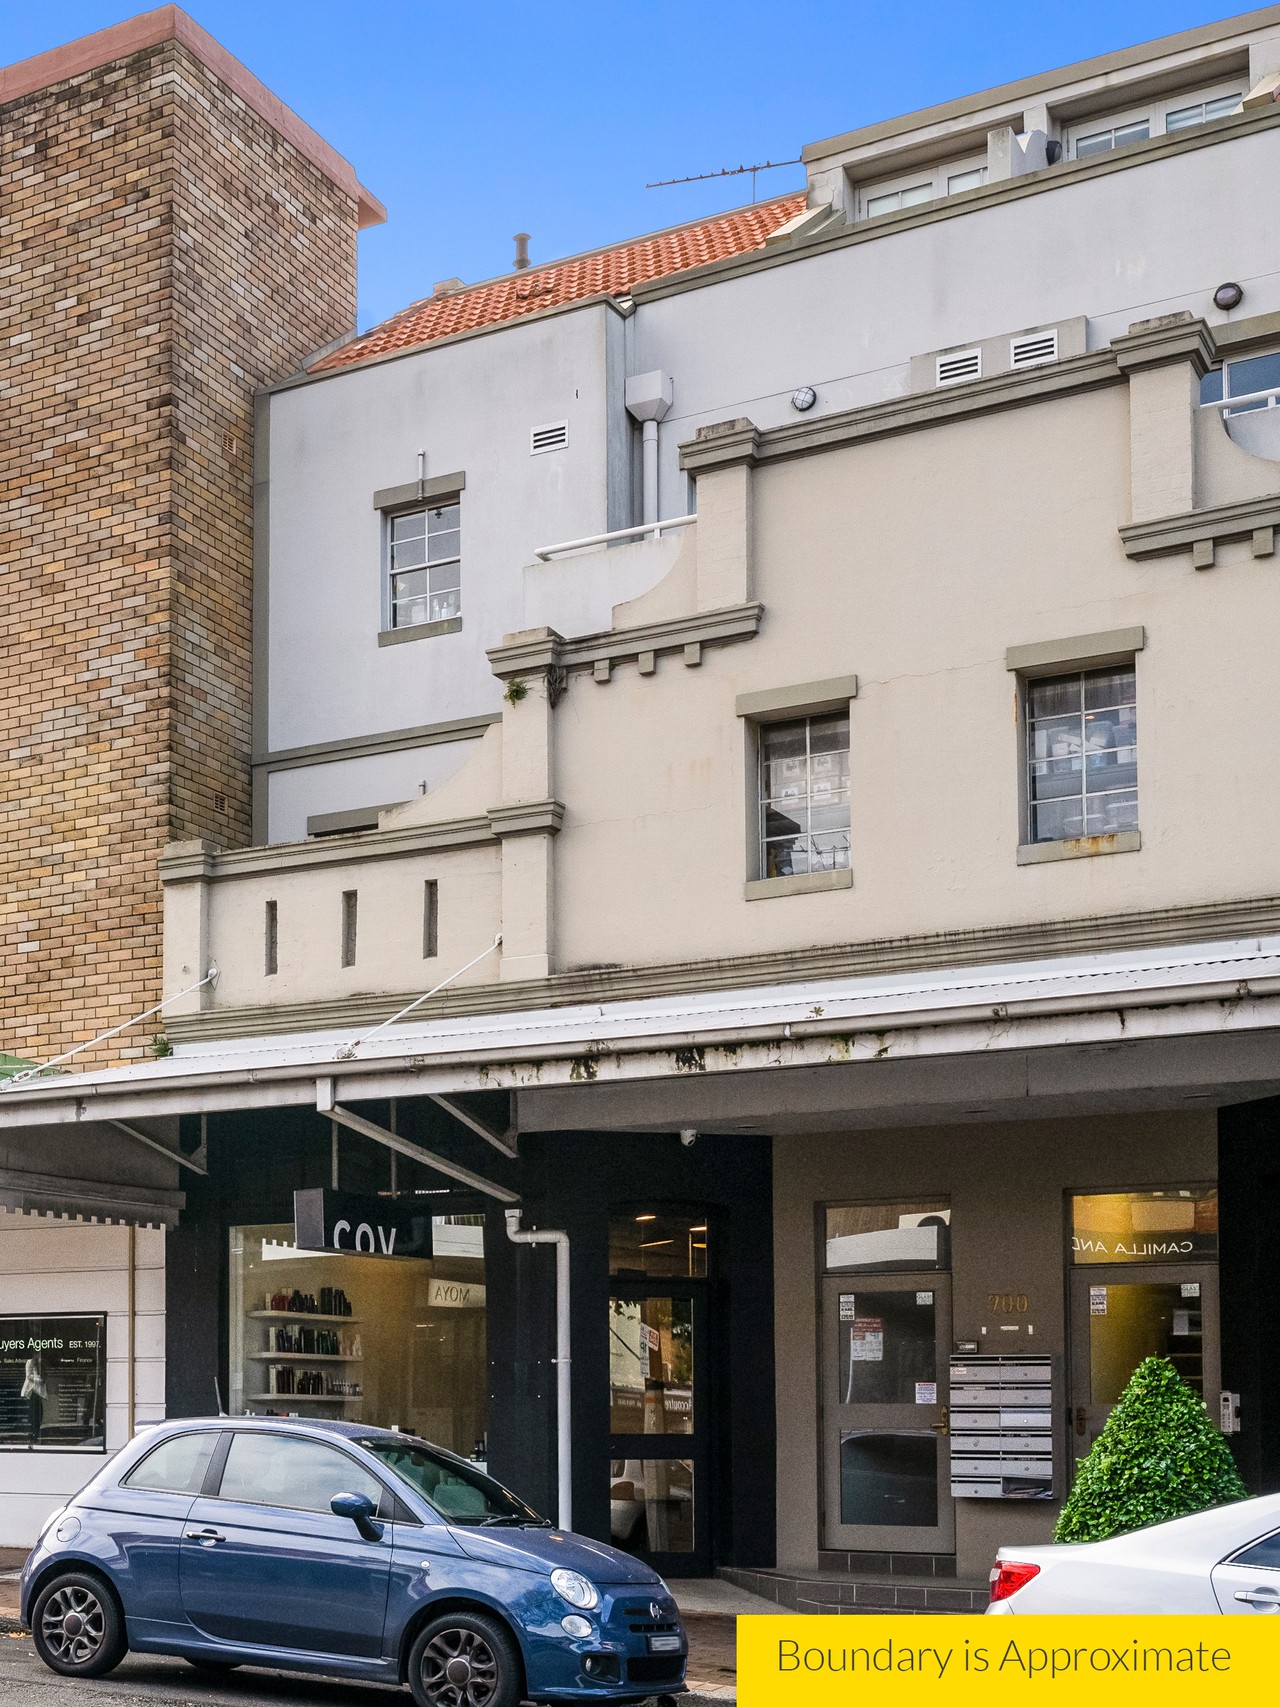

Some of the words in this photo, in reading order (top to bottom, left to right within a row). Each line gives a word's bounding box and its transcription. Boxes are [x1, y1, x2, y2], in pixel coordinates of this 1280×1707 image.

[988, 1294, 1029, 1314] 700
[27, 1337, 64, 1352] Agents
[68, 1340, 83, 1349] EST.
